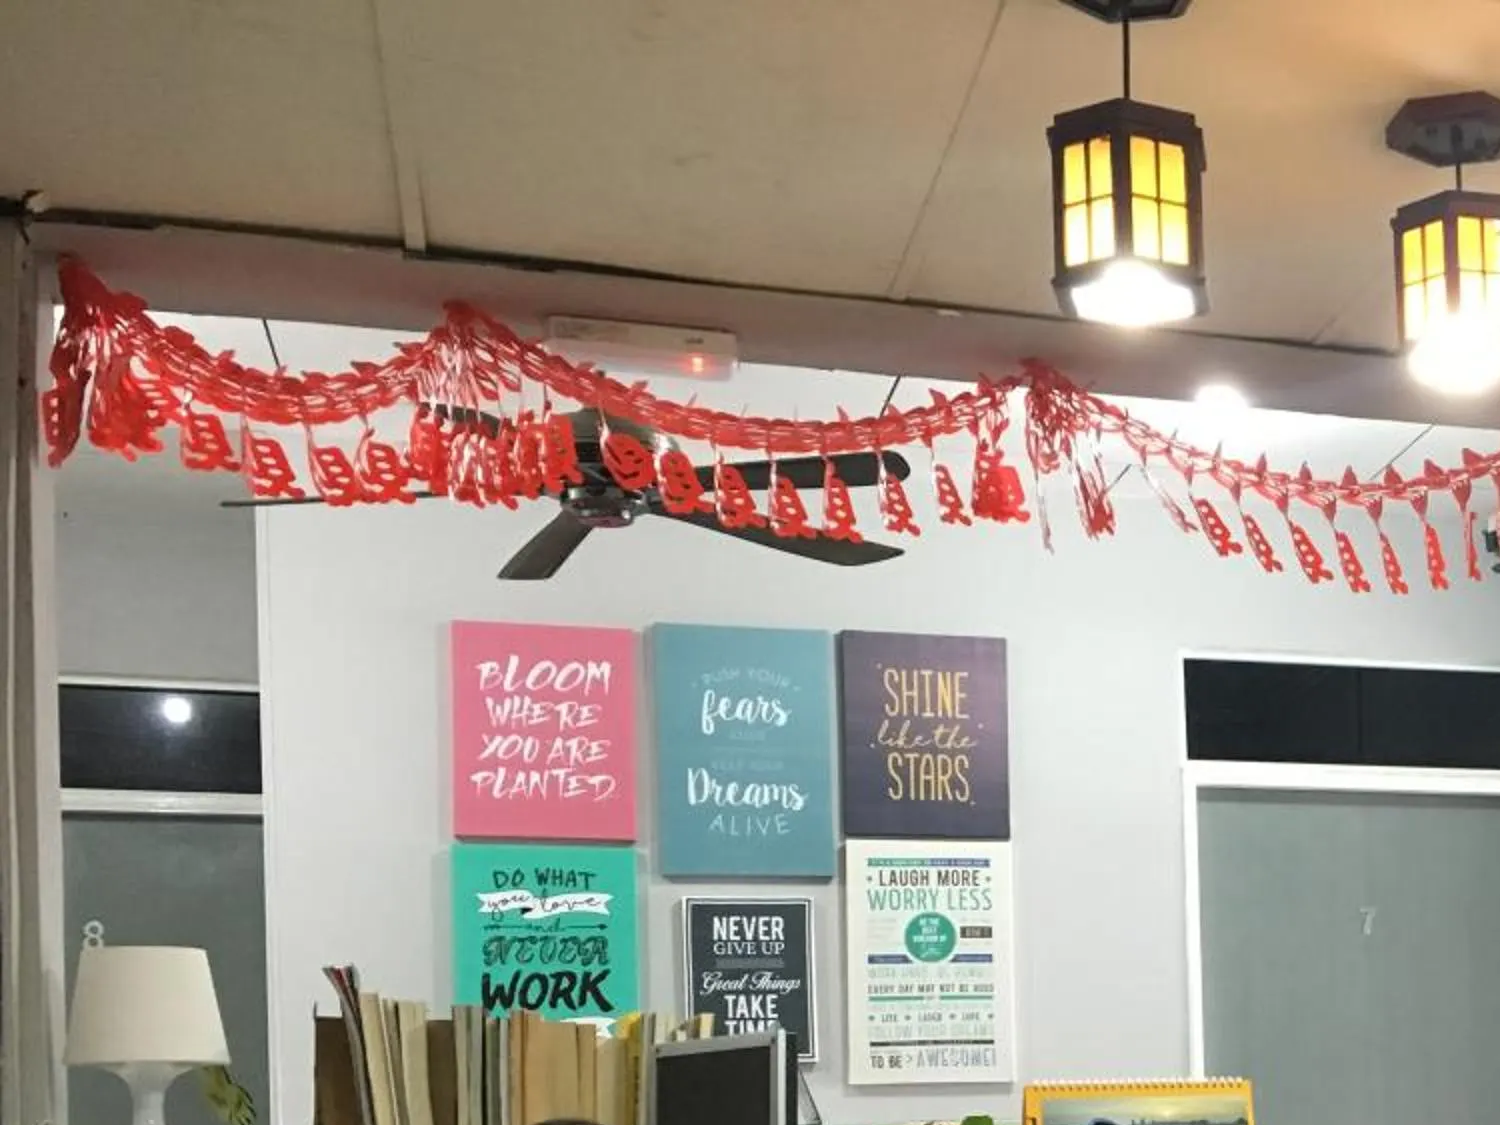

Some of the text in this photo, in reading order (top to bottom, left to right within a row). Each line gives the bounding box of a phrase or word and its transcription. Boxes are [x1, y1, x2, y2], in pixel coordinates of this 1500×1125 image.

[475, 654, 612, 696] BLOOM
[883, 667, 970, 719] SHINE
[485, 695, 603, 731] WHERE
[702, 689, 792, 735] fears
[877, 719, 979, 749] like the
[477, 734, 612, 768] YOU ARE
[469, 766, 617, 801] PLANTED
[687, 767, 809, 811] Dreams
[887, 751, 970, 803] STARS
[708, 813, 793, 837] ALIVE
[492, 867, 597, 890] DO WHAT
[878, 869, 981, 887] LAUGH MORE
[867, 887, 993, 911] WORRY LESS
[712, 915, 785, 941] NEVER
[1359, 906, 1377, 936] 7
[713, 941, 785, 955] GIVE UP
[481, 968, 616, 1012] WORK
[699, 971, 801, 996] Great Things
[723, 994, 779, 1018] TAKE
[724, 1019, 776, 1037] TIM
